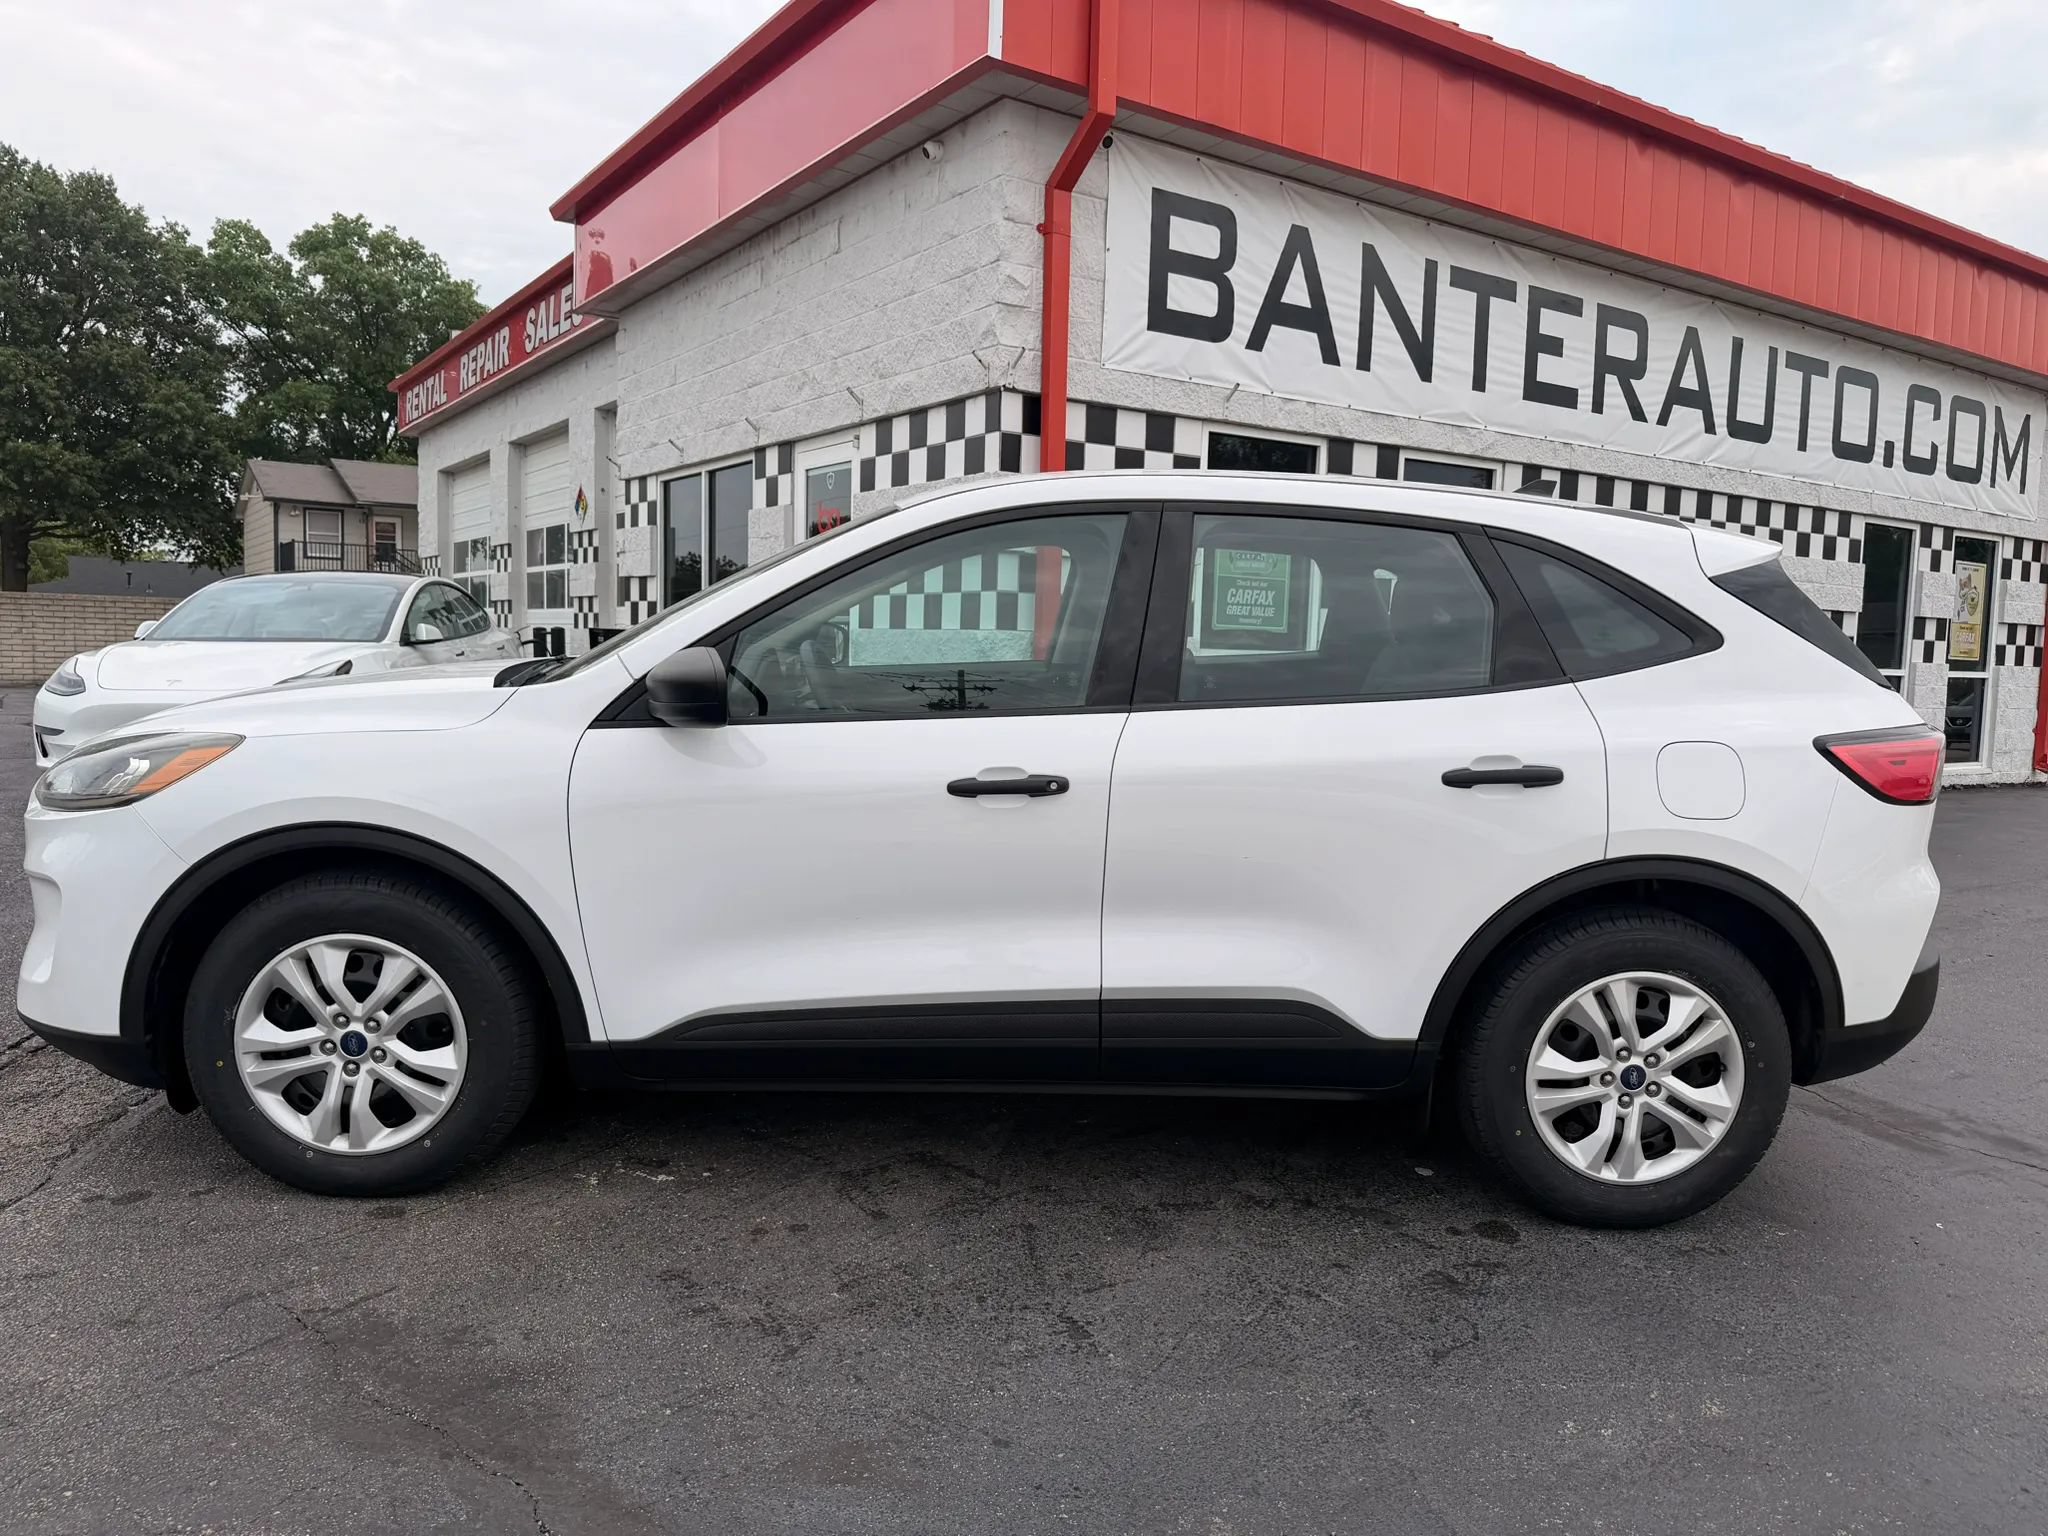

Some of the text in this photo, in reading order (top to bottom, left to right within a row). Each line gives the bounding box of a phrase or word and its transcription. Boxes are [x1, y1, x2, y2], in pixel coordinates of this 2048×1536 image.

[405, 283, 584, 423] RENTAL REPAIR SALE
[1147, 187, 2032, 495] BANTERAUTO.COM
[1226, 605, 1276, 617] GREAT VALUE
[1227, 588, 1276, 606] CARFAX
